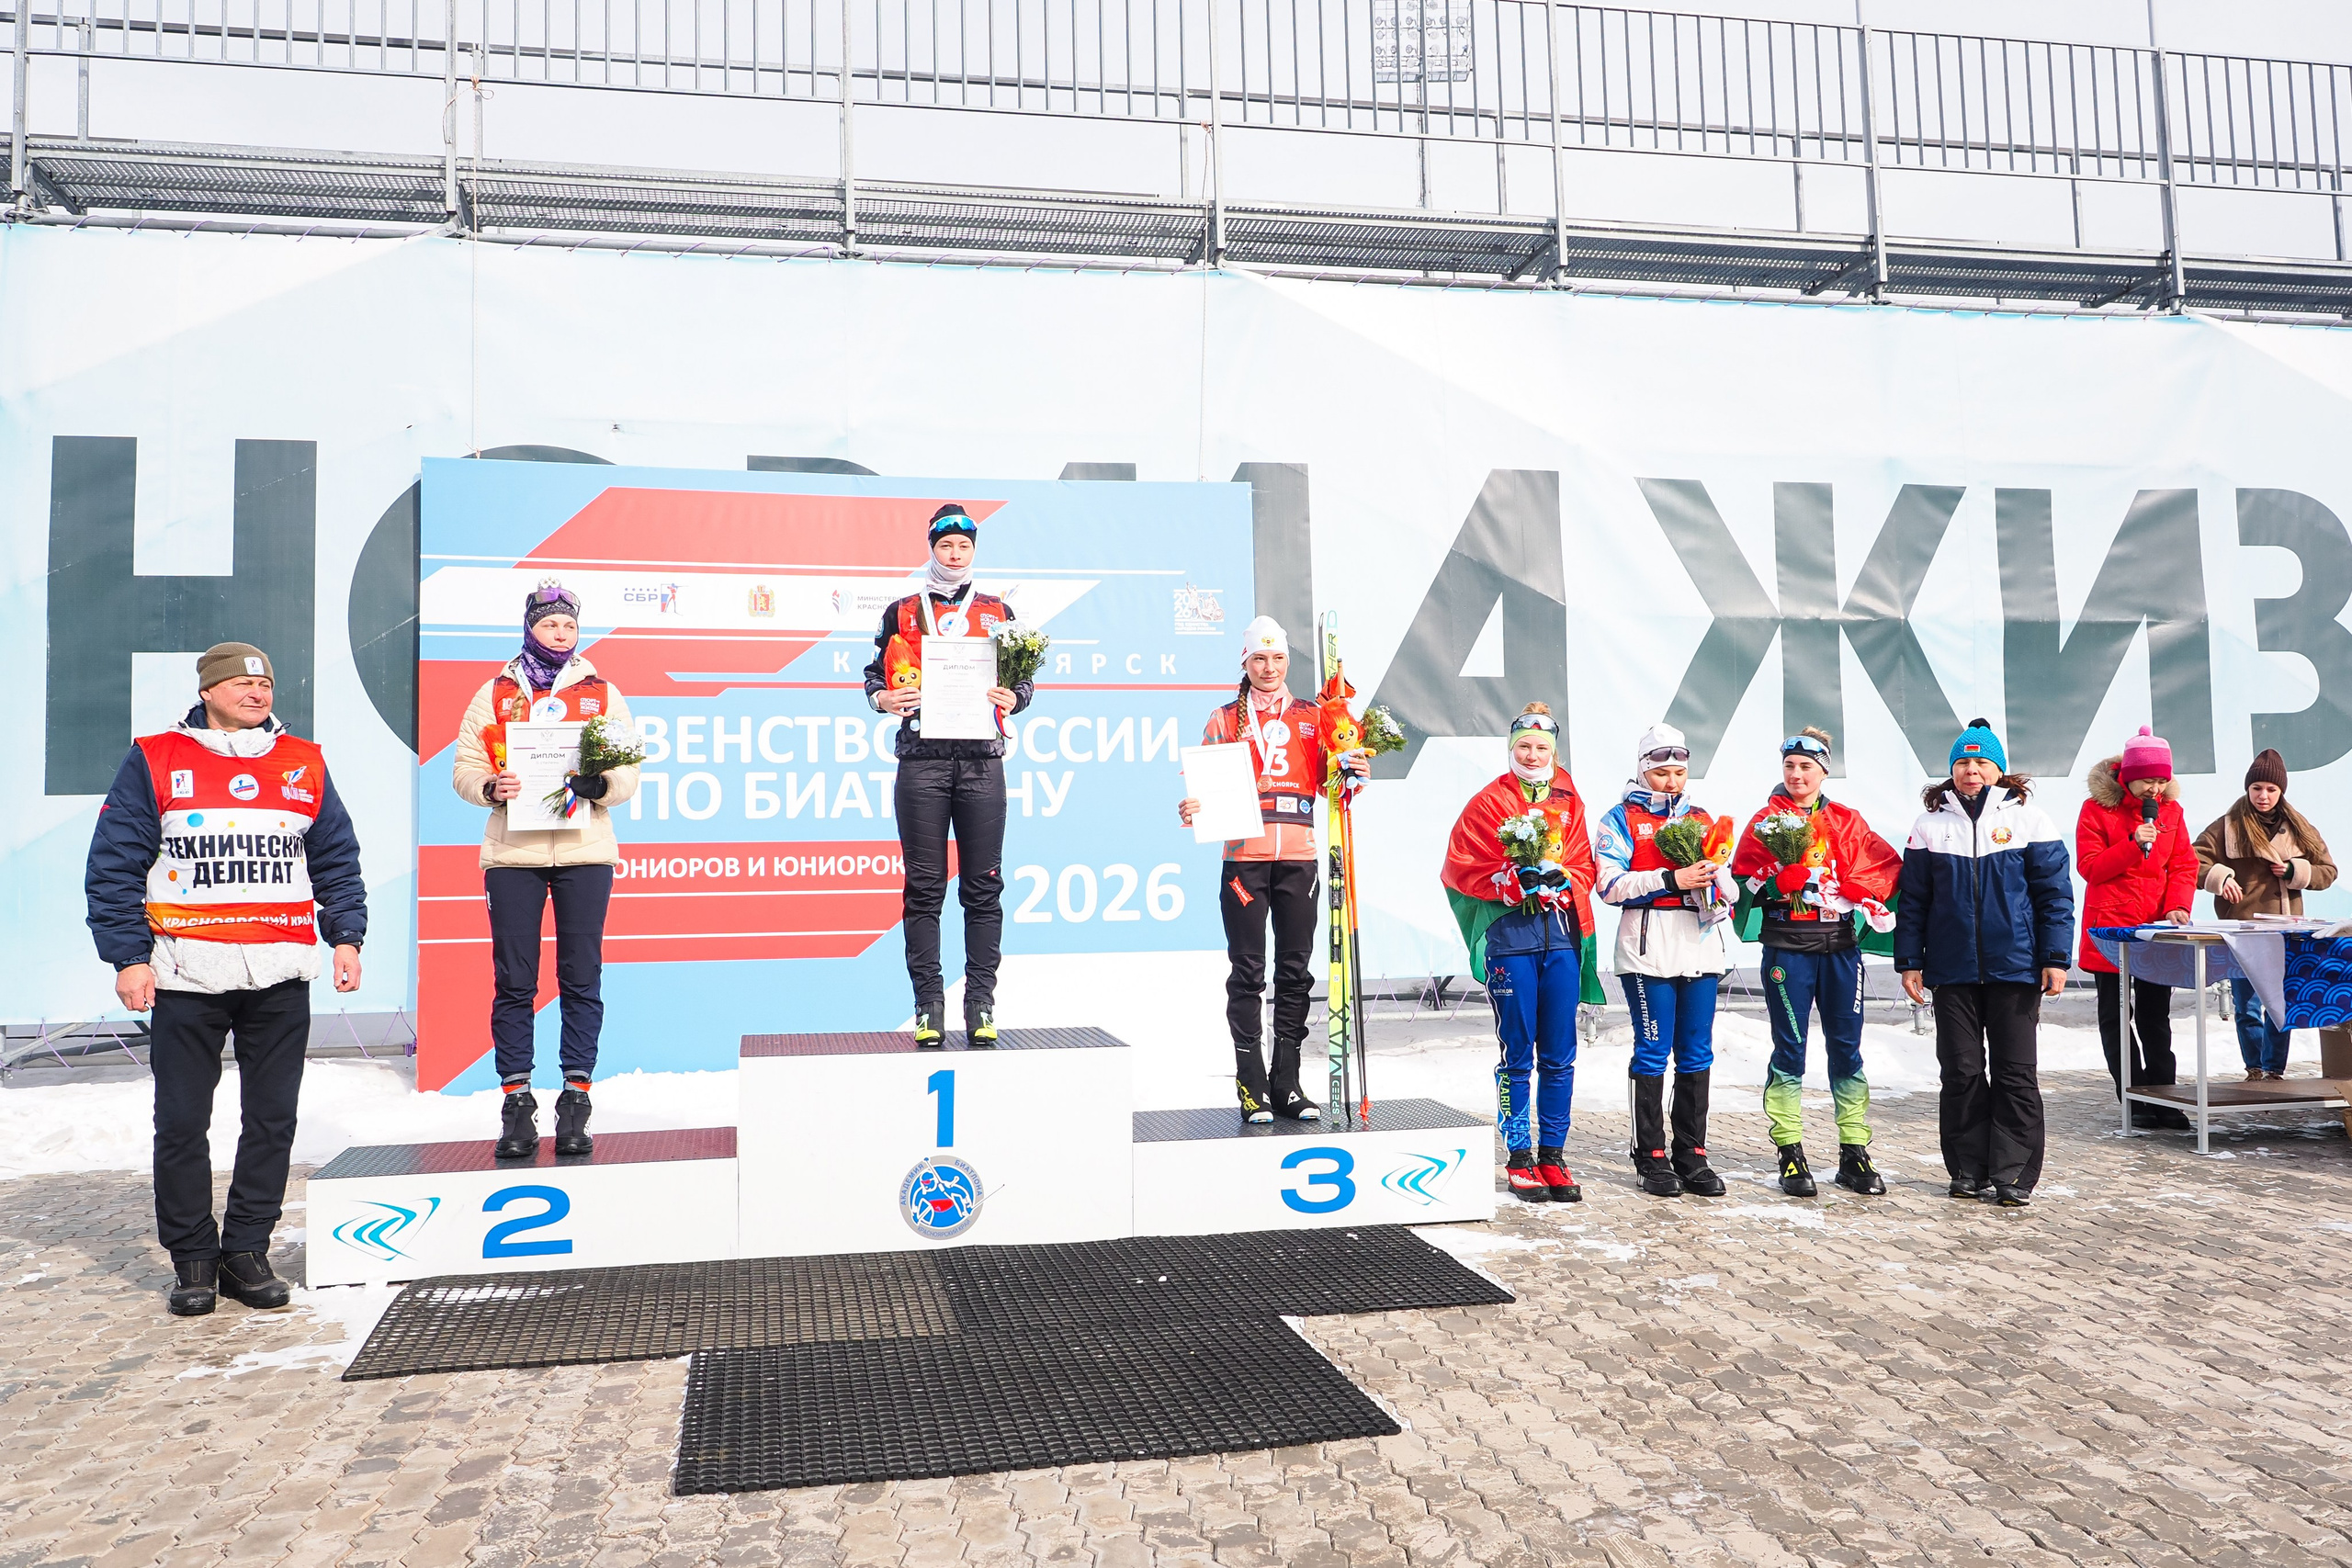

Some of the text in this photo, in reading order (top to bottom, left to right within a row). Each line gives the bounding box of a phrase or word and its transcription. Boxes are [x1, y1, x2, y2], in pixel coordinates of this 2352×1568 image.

[623, 592, 659, 602] СБР
[629, 772, 723, 821] ПО
[1272, 781, 1300, 789] СНОЯРСК
[193, 861, 293, 888] ДЕЛЕГАТ
[747, 856, 765, 877] И
[1012, 863, 1185, 923] 2026
[928, 1070, 955, 1147] 1
[1332, 1080, 1340, 1114] SPEED
[900, 1159, 983, 1206] АКАДЕМИЯ БИАТЛОНА
[1281, 1146, 1356, 1213] 3
[482, 1185, 573, 1259] 2
